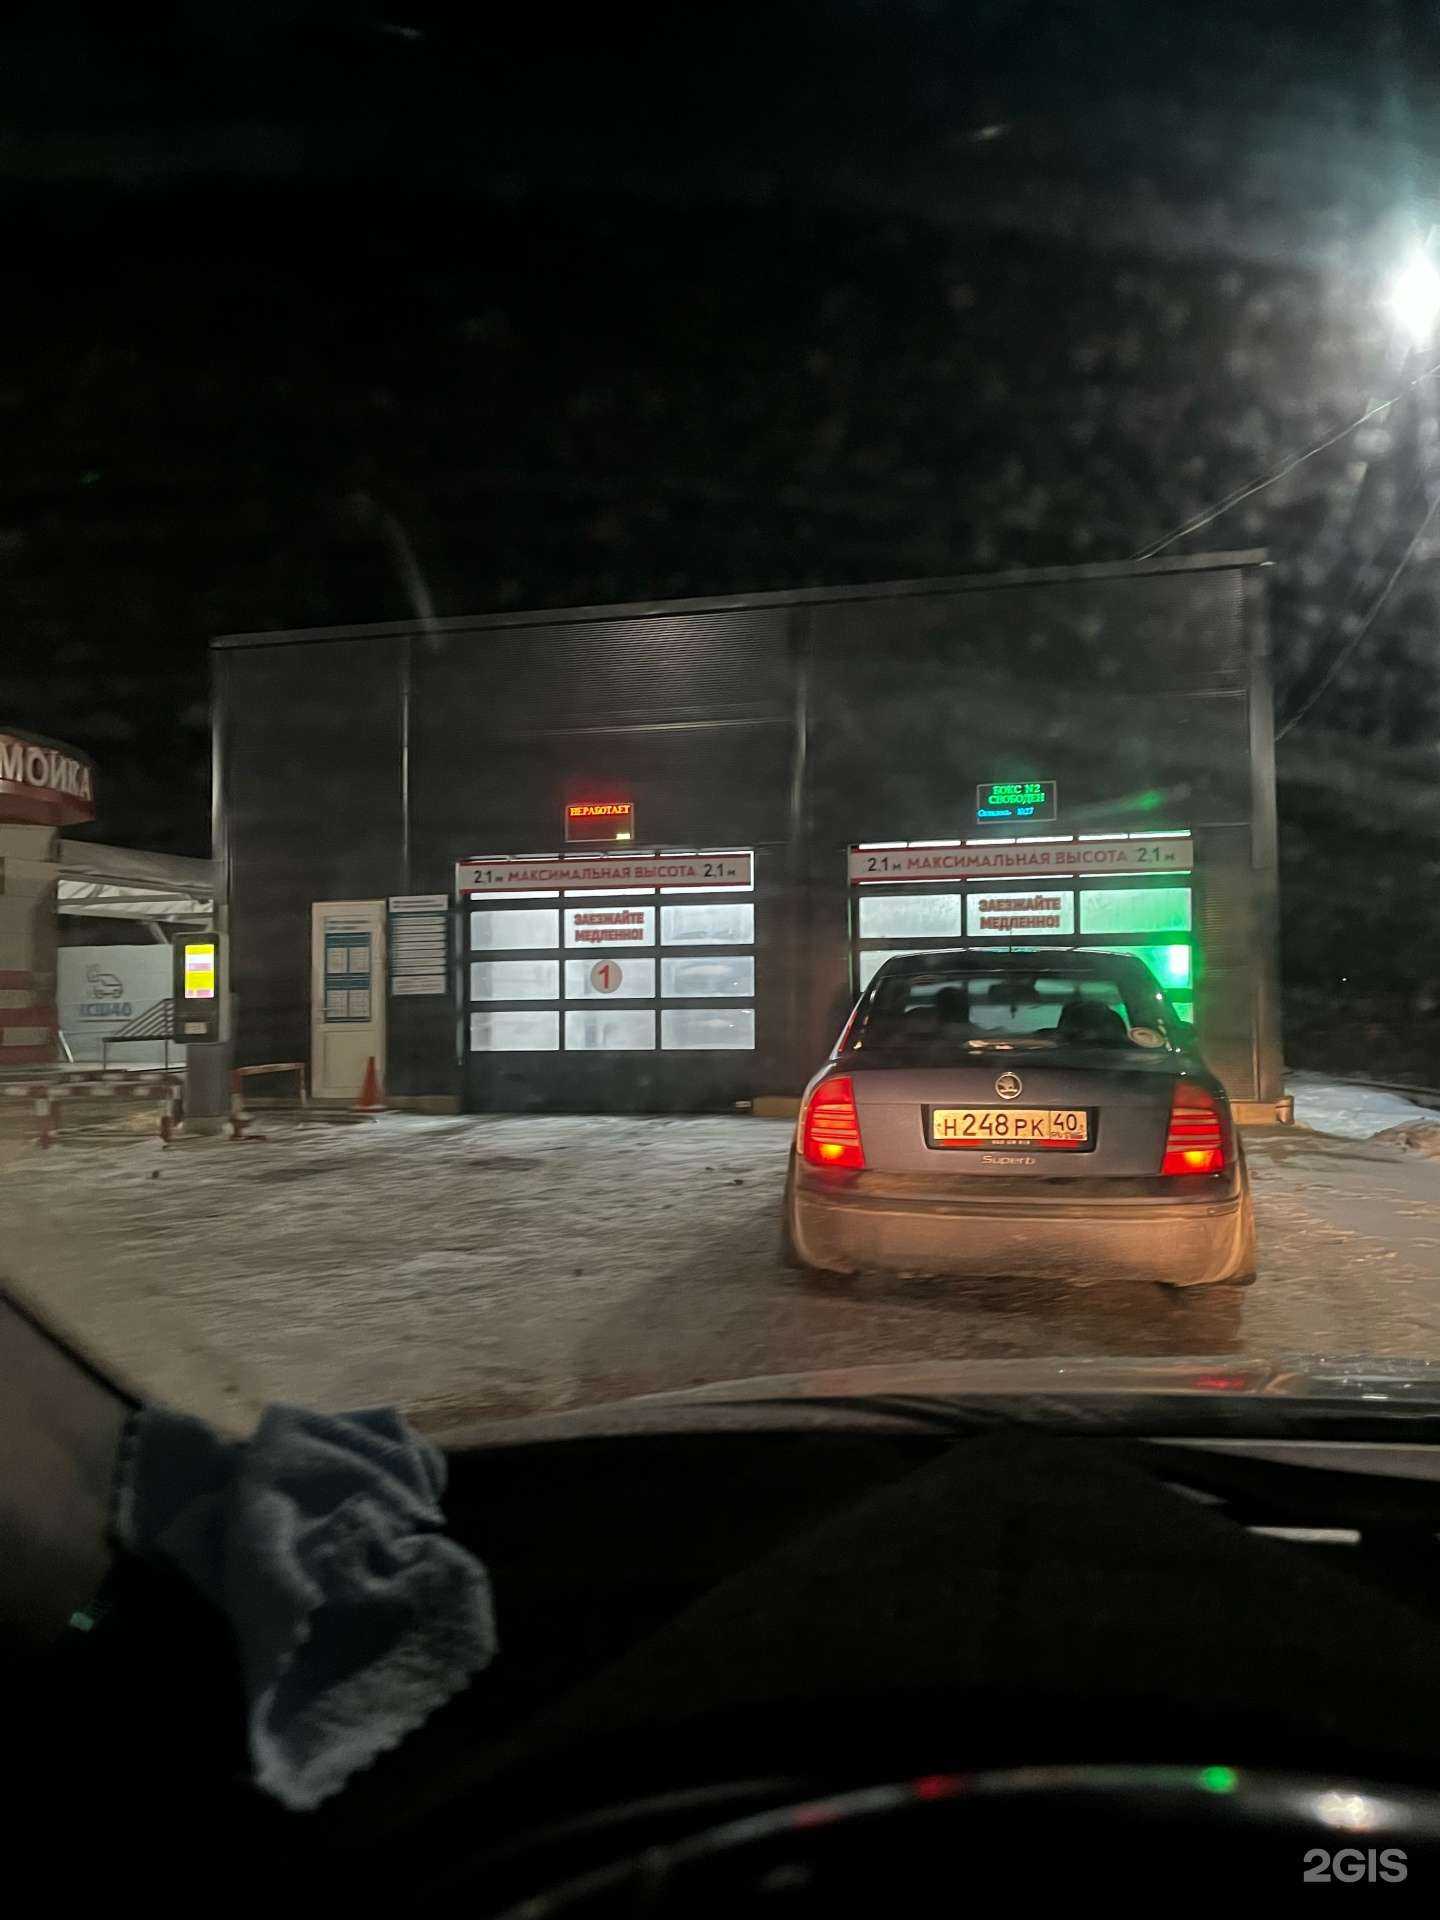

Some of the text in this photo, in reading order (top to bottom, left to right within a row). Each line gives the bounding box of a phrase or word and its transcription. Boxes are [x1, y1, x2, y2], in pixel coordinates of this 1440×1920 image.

[907, 852, 1050, 870] МАКСИМАЛЬНАЯ
[1055, 849, 1128, 865] ВЫСОТА
[508, 867, 630, 882] МАКСИМАЛЬНАЯ
[634, 865, 695, 878] ВЫСОТА
[978, 894, 1062, 913] ЗАЕЗЖАЙТЕ
[574, 909, 645, 925] ЗАЕЗЖАЙТЕ
[979, 914, 1060, 931] МЕДЛЕННО!
[598, 964, 610, 989] 1
[1053, 1113, 1078, 1132] 40
[981, 1154, 1037, 1166] Superb
